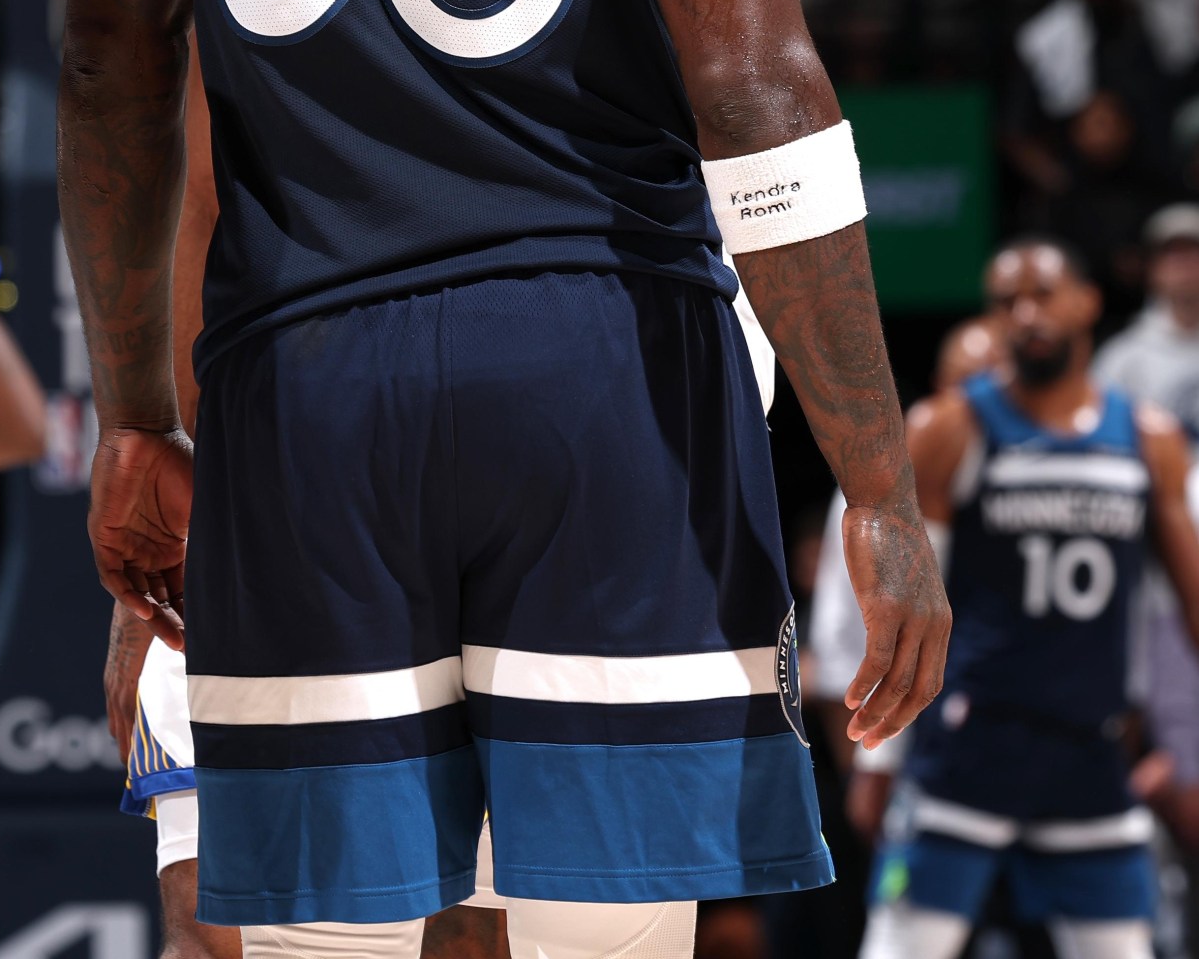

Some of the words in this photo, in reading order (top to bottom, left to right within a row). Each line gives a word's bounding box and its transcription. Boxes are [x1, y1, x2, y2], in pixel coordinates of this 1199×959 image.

[730, 180, 802, 206] Kendra
[1019, 536, 1116, 620] 10
[780, 614, 794, 693] MINNESO
